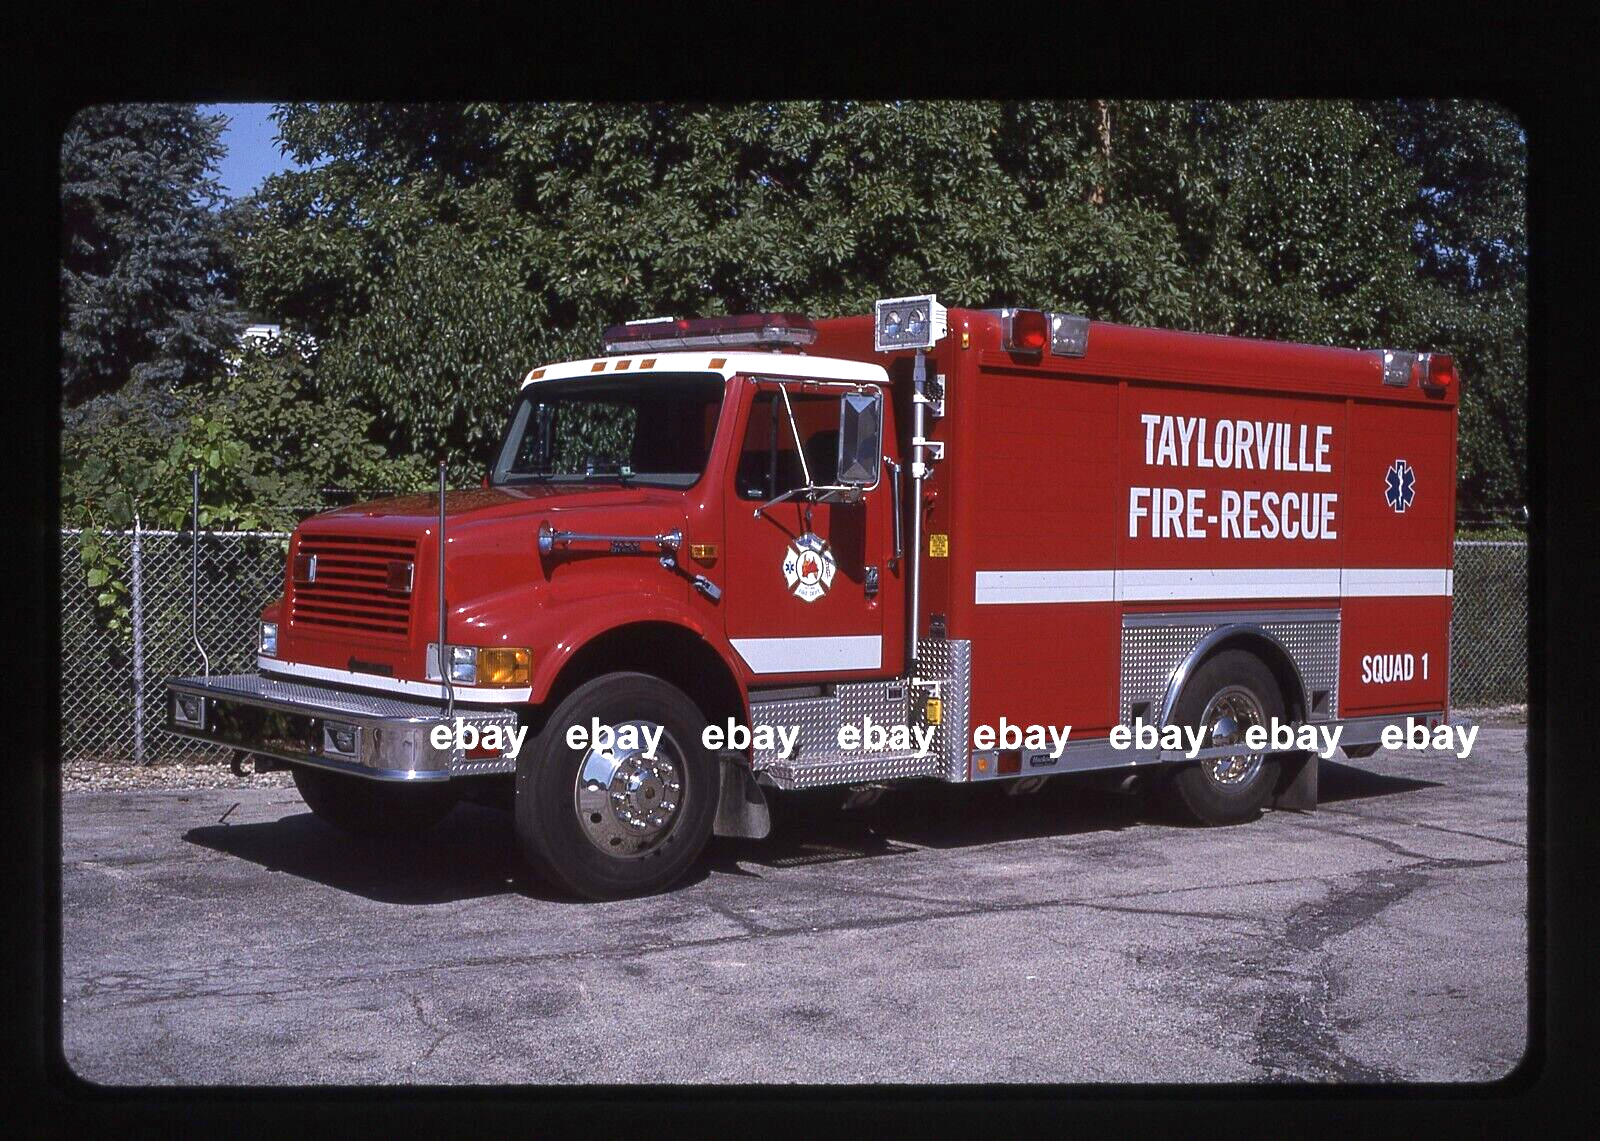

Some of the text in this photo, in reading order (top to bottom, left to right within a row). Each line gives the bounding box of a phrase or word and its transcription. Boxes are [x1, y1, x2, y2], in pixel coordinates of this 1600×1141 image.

[1141, 413, 1332, 473] TAYLORVILLE
[1129, 487, 1337, 540] FIRE-RESCUE
[1361, 653, 1429, 685] SQUAD 1
